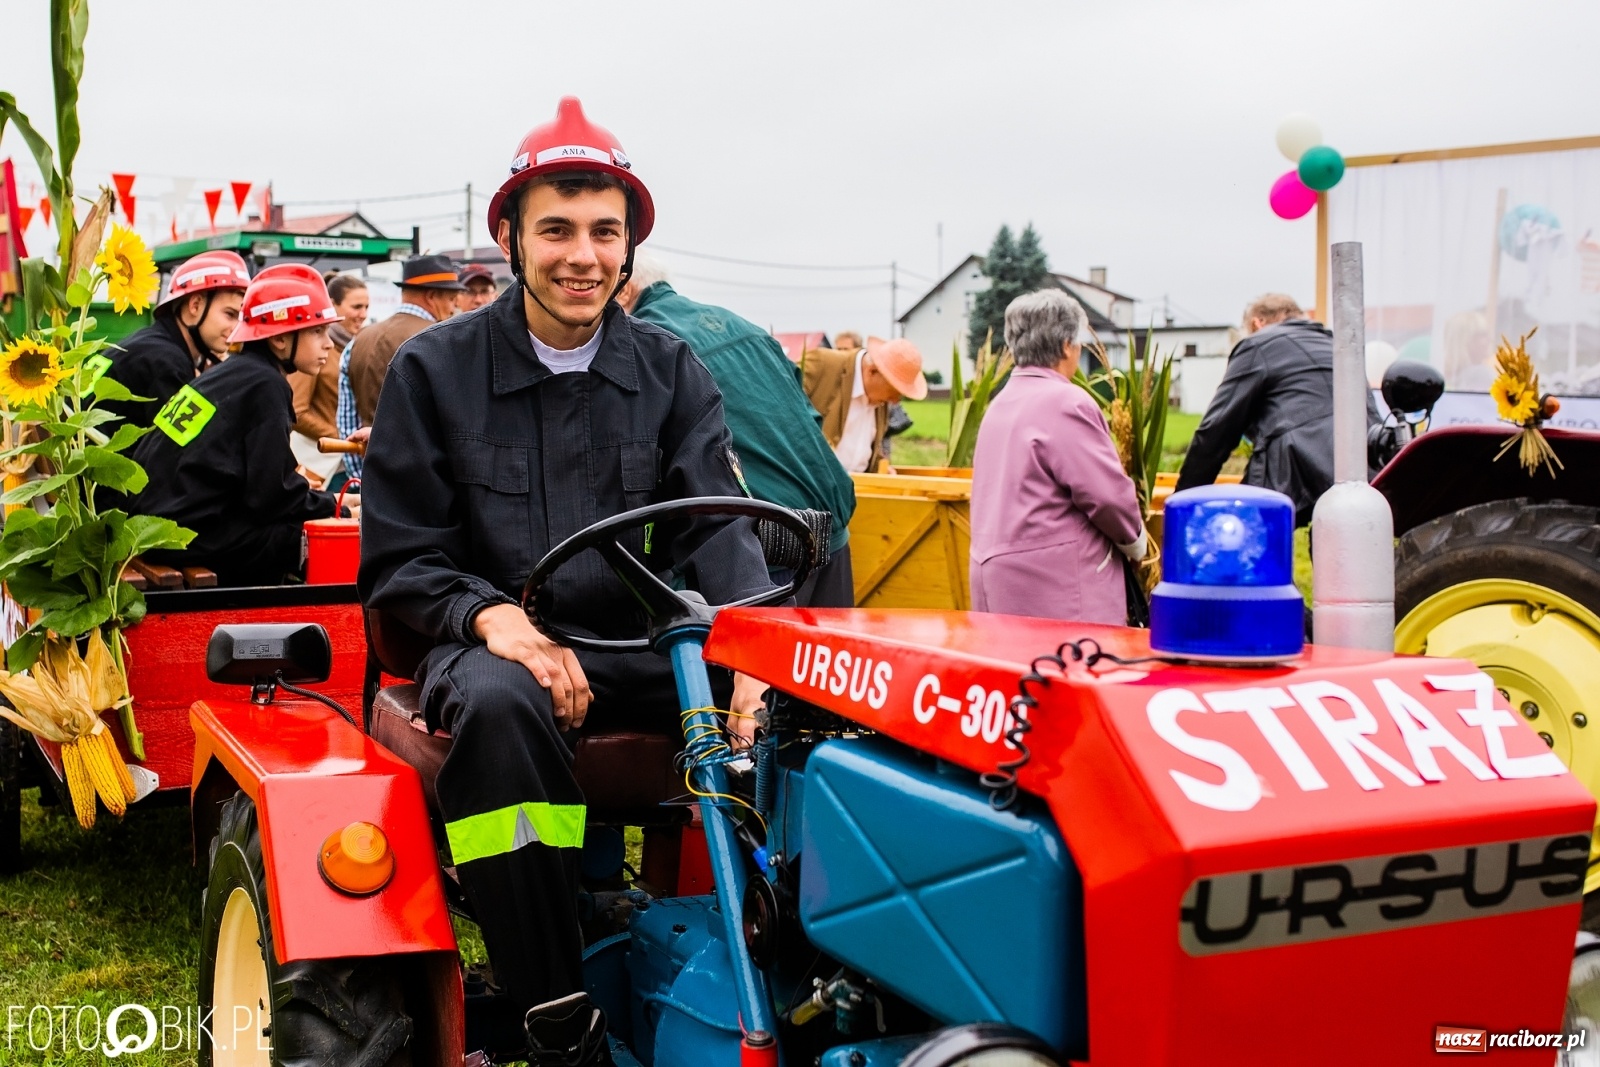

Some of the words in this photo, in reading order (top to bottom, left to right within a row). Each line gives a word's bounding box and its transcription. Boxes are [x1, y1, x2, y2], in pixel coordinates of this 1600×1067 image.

[561, 148, 587, 156] ANIA
[792, 641, 893, 710] URSUS
[1191, 834, 1592, 945] URSUS
